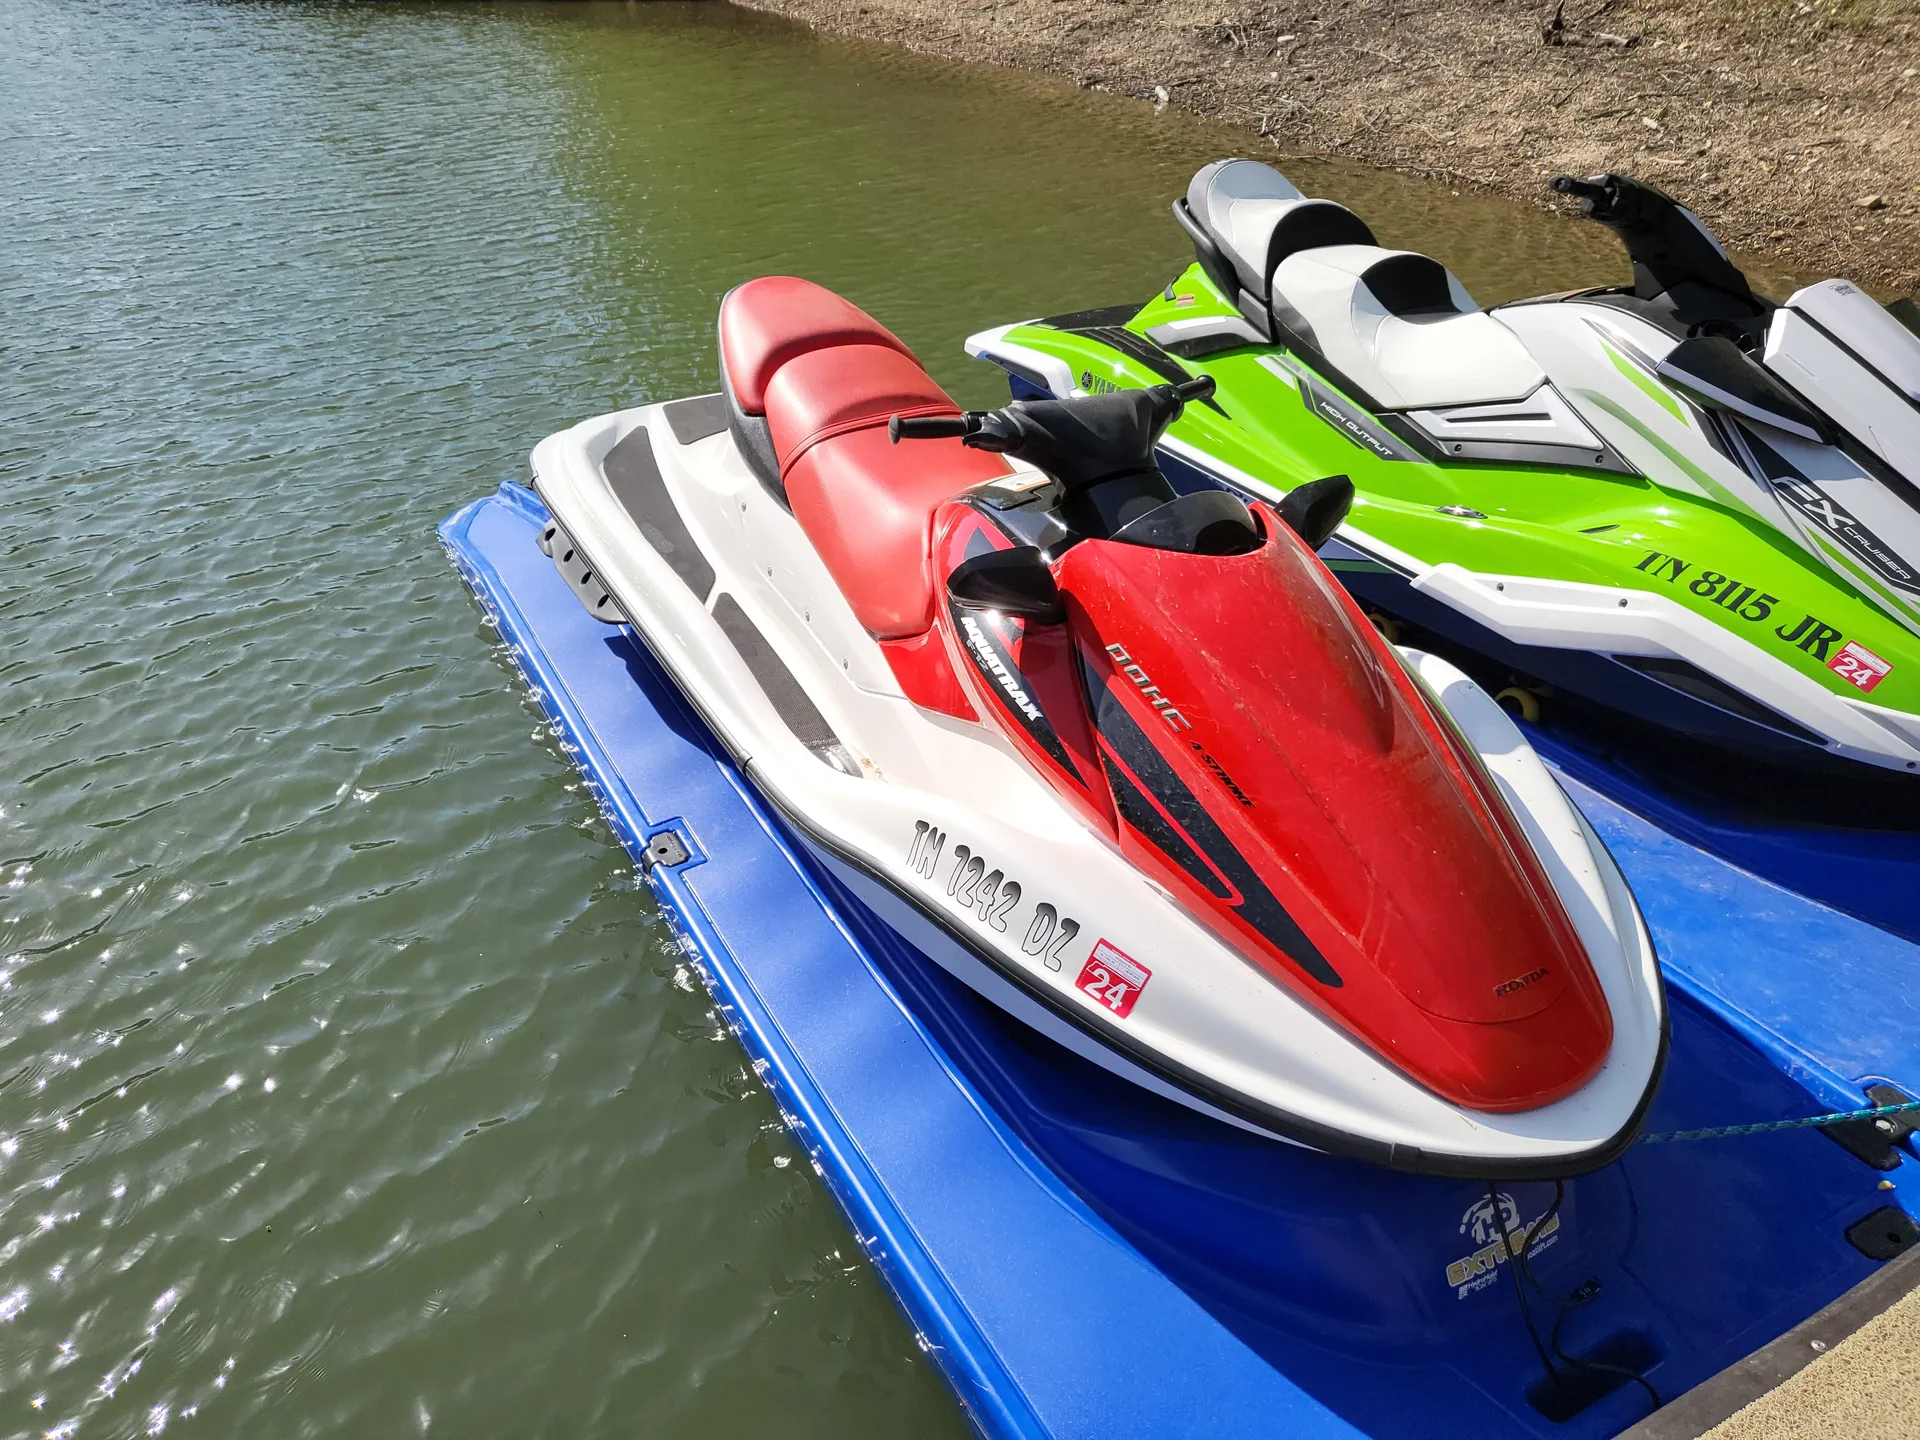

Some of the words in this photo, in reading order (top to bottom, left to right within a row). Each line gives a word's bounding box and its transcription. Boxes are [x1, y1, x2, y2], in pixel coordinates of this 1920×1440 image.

[1320, 402, 1347, 423] HIGH
[1346, 421, 1393, 455] OUTPUT
[1771, 476, 1856, 529] FX
[1844, 526, 1911, 580] CRUISER
[1634, 549, 1693, 584] TN
[1688, 570, 1780, 622] 8115
[1774, 614, 1843, 663] JR
[960, 617, 1044, 721] AQUATRAX
[1105, 643, 1193, 733] DOHC
[1833, 657, 1874, 687] 24
[1201, 754, 1257, 809] STROKE
[905, 819, 946, 880] TN
[946, 844, 1022, 933] 7242
[1021, 902, 1081, 973] DZ
[1084, 968, 1128, 1011] 24
[1493, 966, 1549, 998] HONDA
